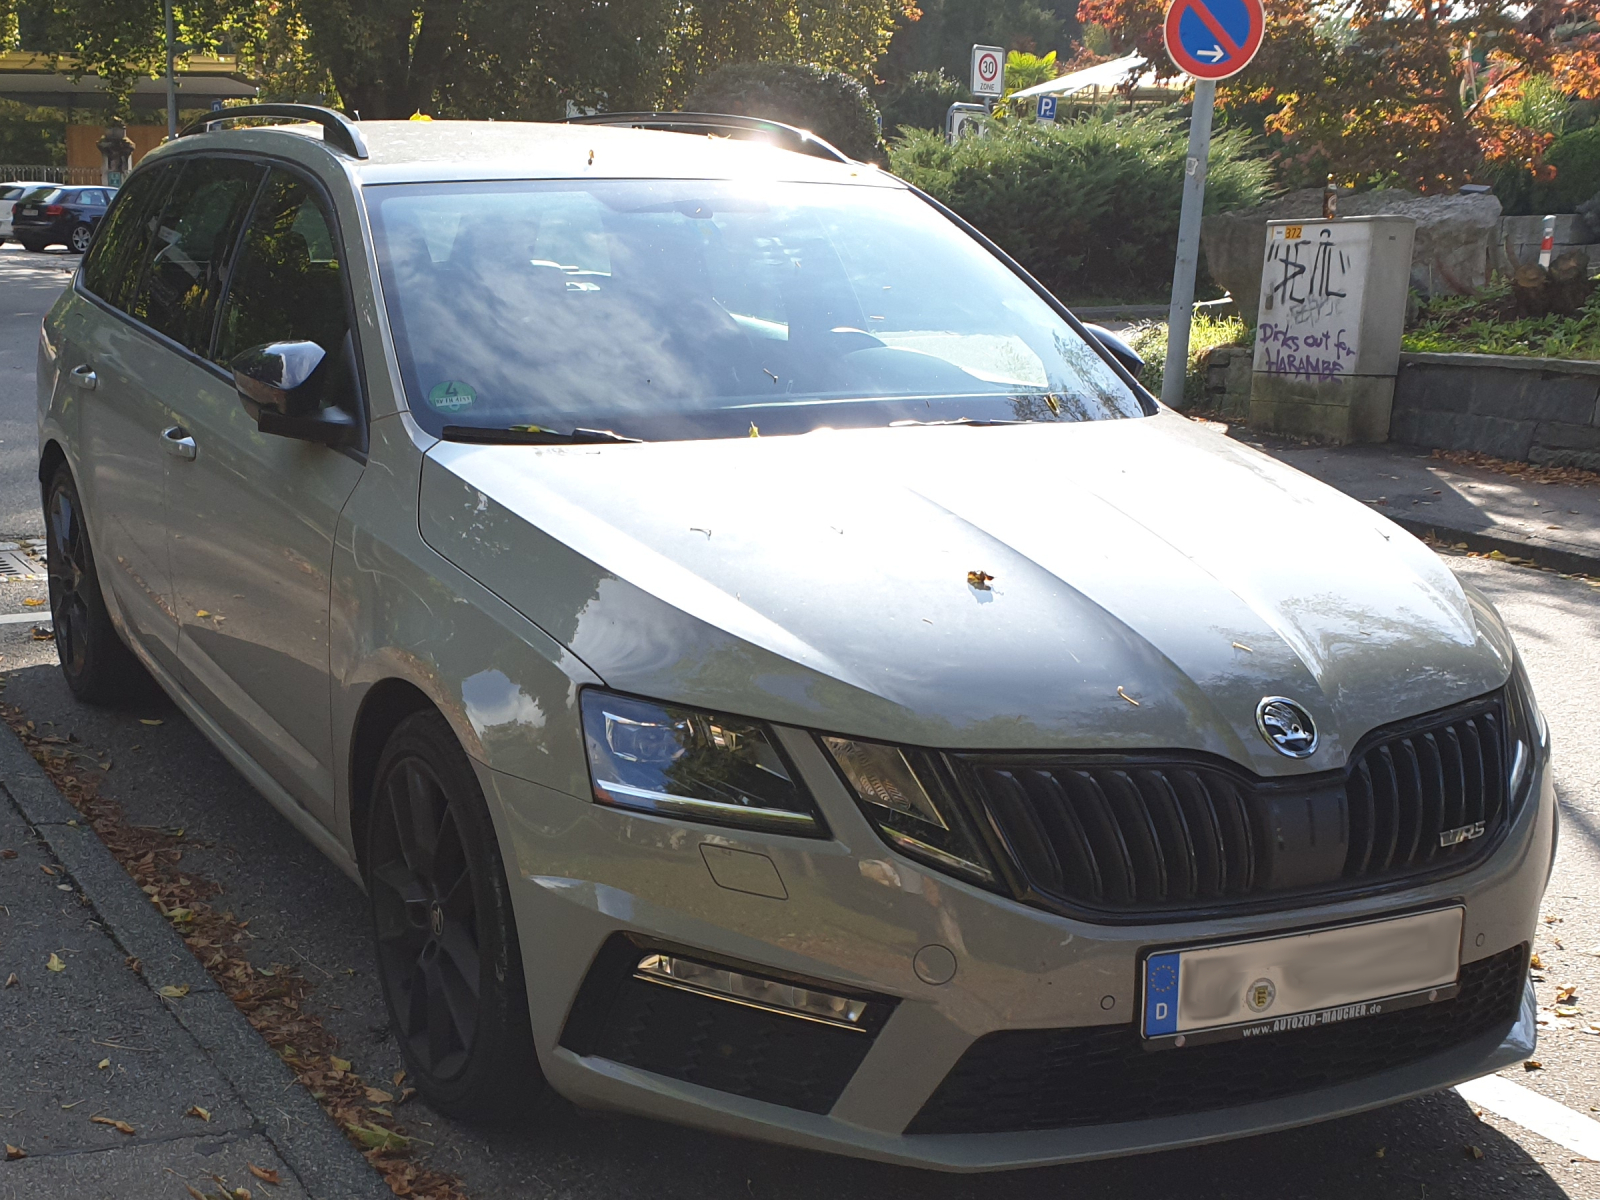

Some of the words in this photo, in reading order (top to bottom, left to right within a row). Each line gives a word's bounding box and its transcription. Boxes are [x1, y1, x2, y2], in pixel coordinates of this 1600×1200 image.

[983, 61, 994, 74] 30
[1041, 98, 1052, 116] P
[1285, 227, 1302, 239] 372
[1265, 347, 1345, 384] HARAMBE
[445, 382, 459, 396] 4
[1155, 1002, 1168, 1020] D
[1242, 1003, 1382, 1037] www.AUTOZOO-MAUCHER.de
